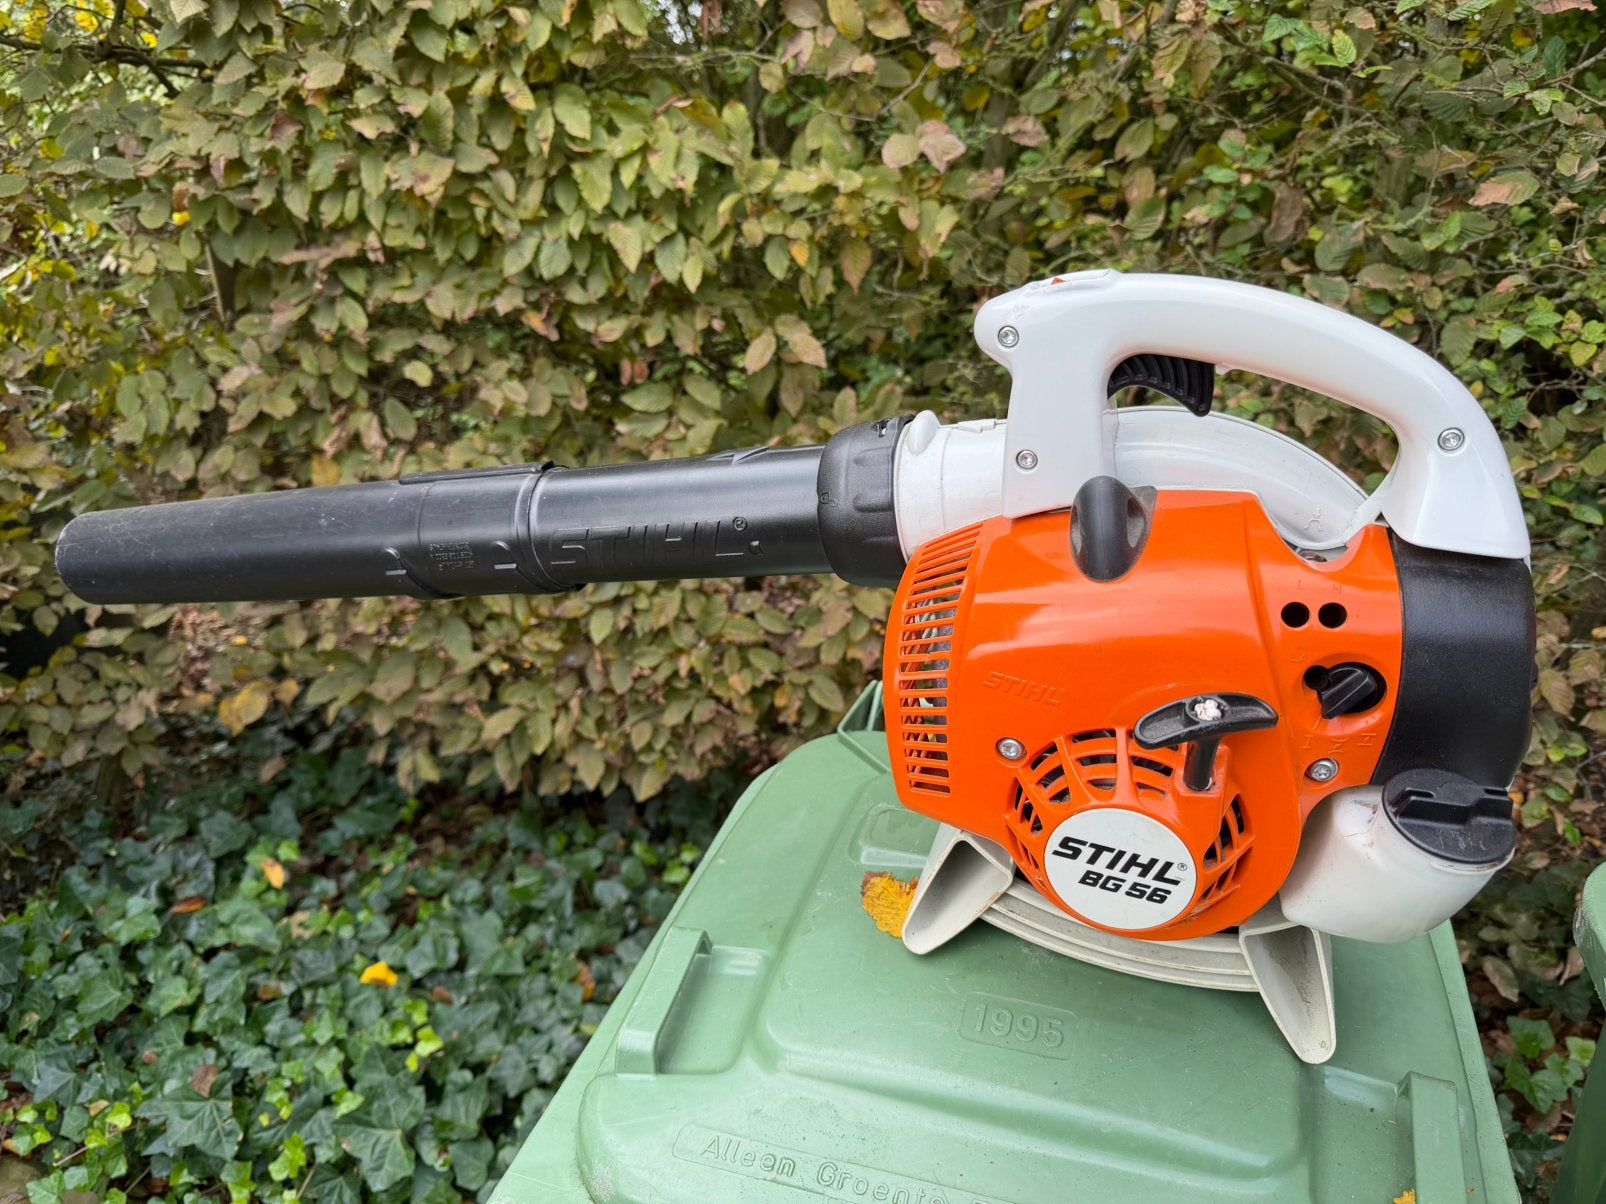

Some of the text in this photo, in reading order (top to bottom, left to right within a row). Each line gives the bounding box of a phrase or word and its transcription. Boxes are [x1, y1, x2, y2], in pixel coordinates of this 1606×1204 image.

[1078, 869, 1172, 905] BG 56
[976, 1003, 1064, 1049] 1995
[700, 1135, 796, 1177] Alleen
